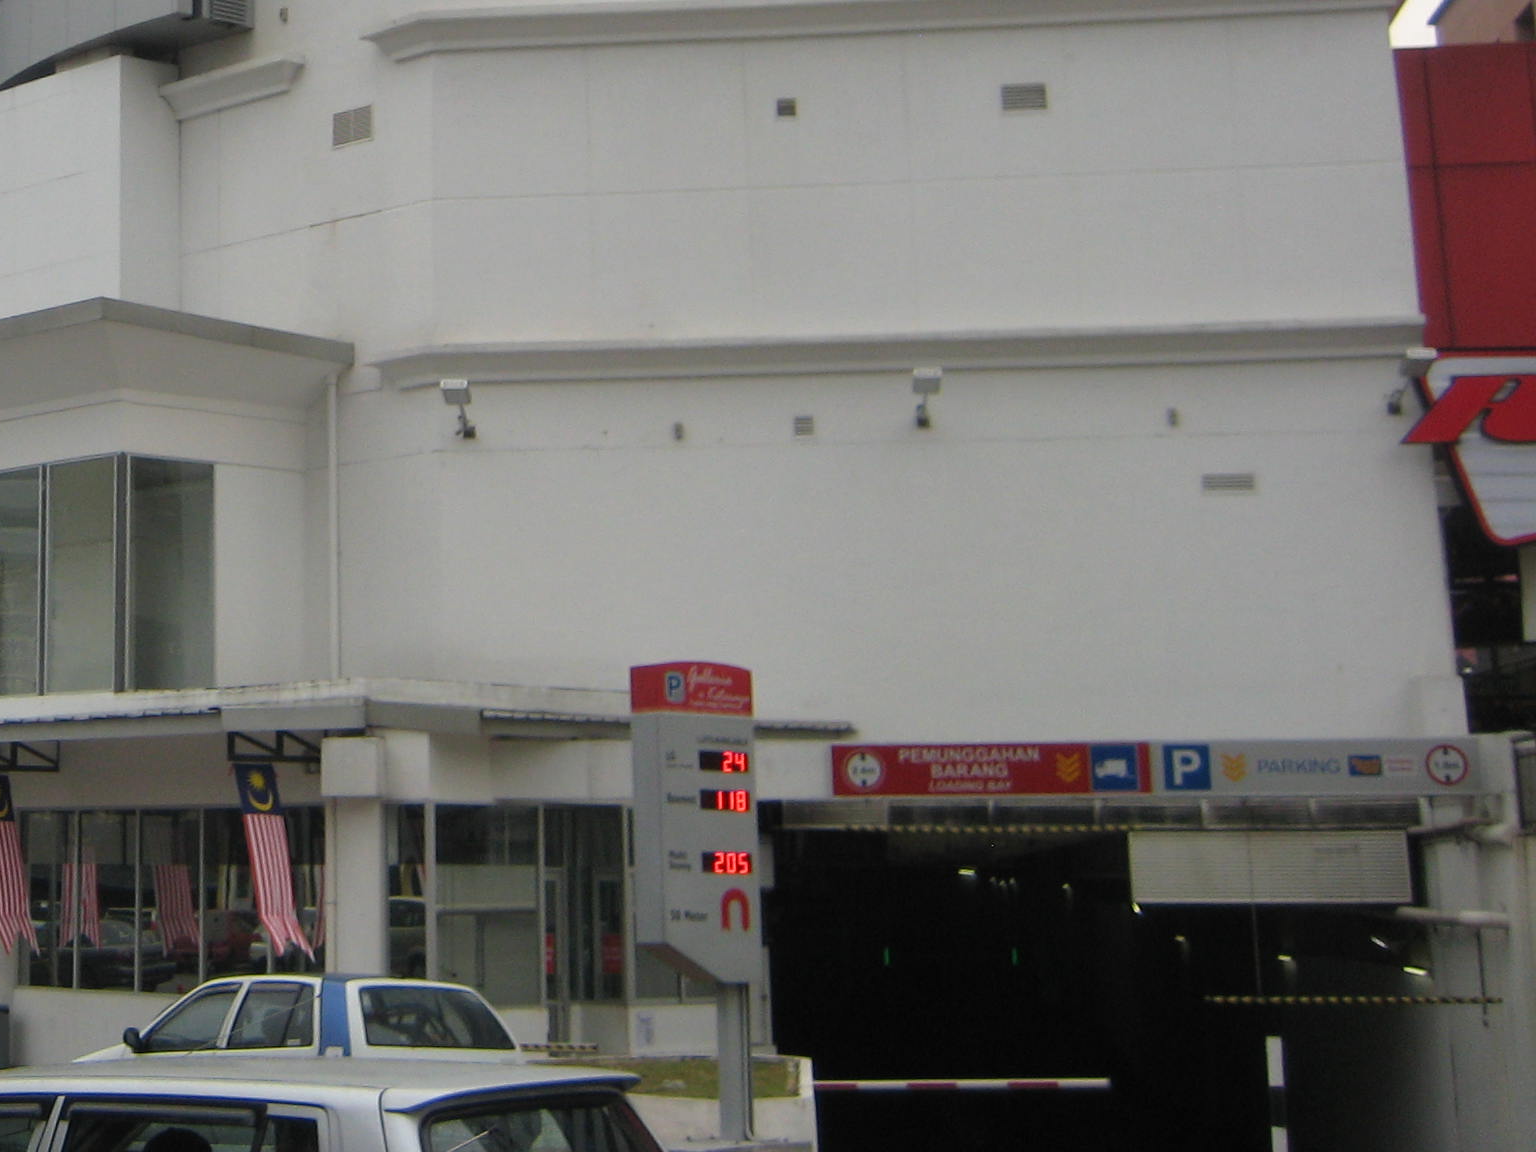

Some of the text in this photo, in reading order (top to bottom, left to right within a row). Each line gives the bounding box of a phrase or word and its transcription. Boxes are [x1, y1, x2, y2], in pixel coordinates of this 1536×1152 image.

[667, 674, 682, 697] P
[722, 751, 746, 773] 24
[897, 747, 1040, 763] PEMUNGGAHAN
[930, 763, 1009, 779] BARANG
[1171, 750, 1202, 786] P
[1257, 758, 1342, 775] PARKING
[717, 790, 747, 813] 118
[713, 852, 749, 875] 205
